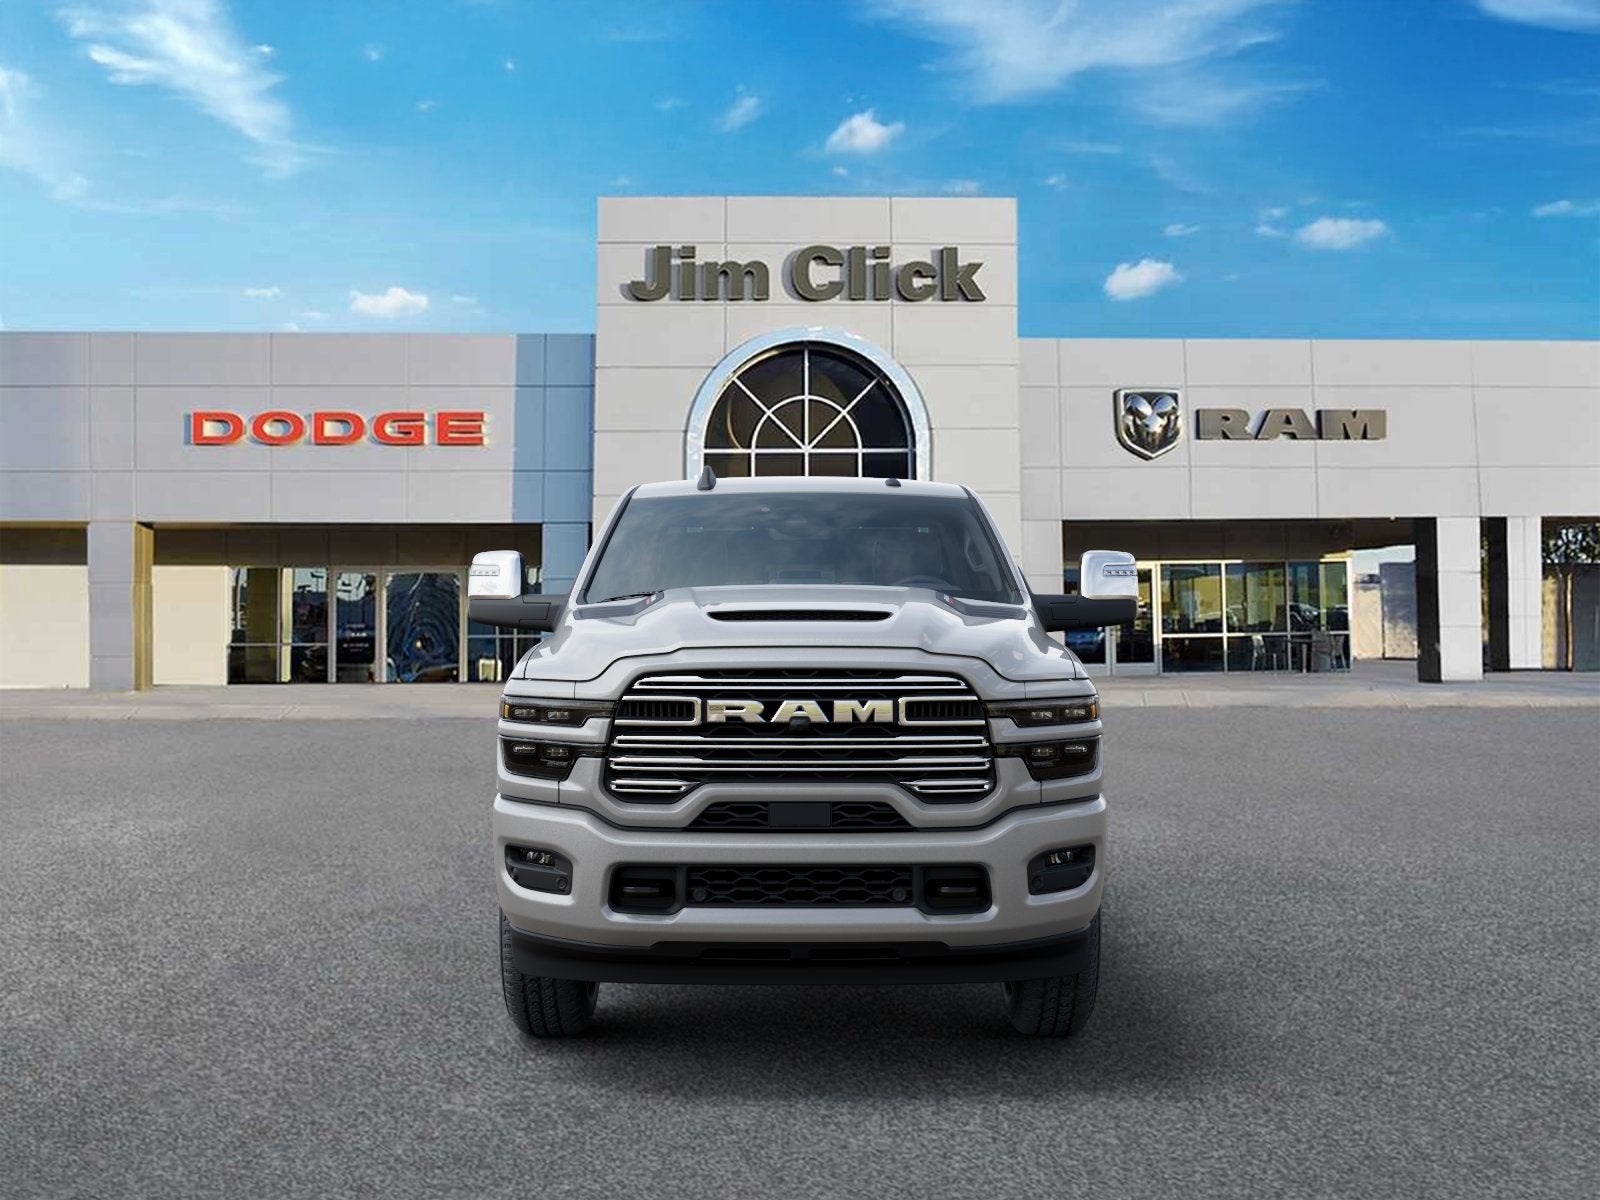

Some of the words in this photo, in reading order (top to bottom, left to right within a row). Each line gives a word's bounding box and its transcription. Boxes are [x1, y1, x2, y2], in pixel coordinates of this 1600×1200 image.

[624, 245, 770, 301] Jim
[786, 244, 986, 301] Click
[188, 410, 487, 446] DODGE
[1195, 408, 1387, 440] RAM
[706, 699, 894, 723] RAM
